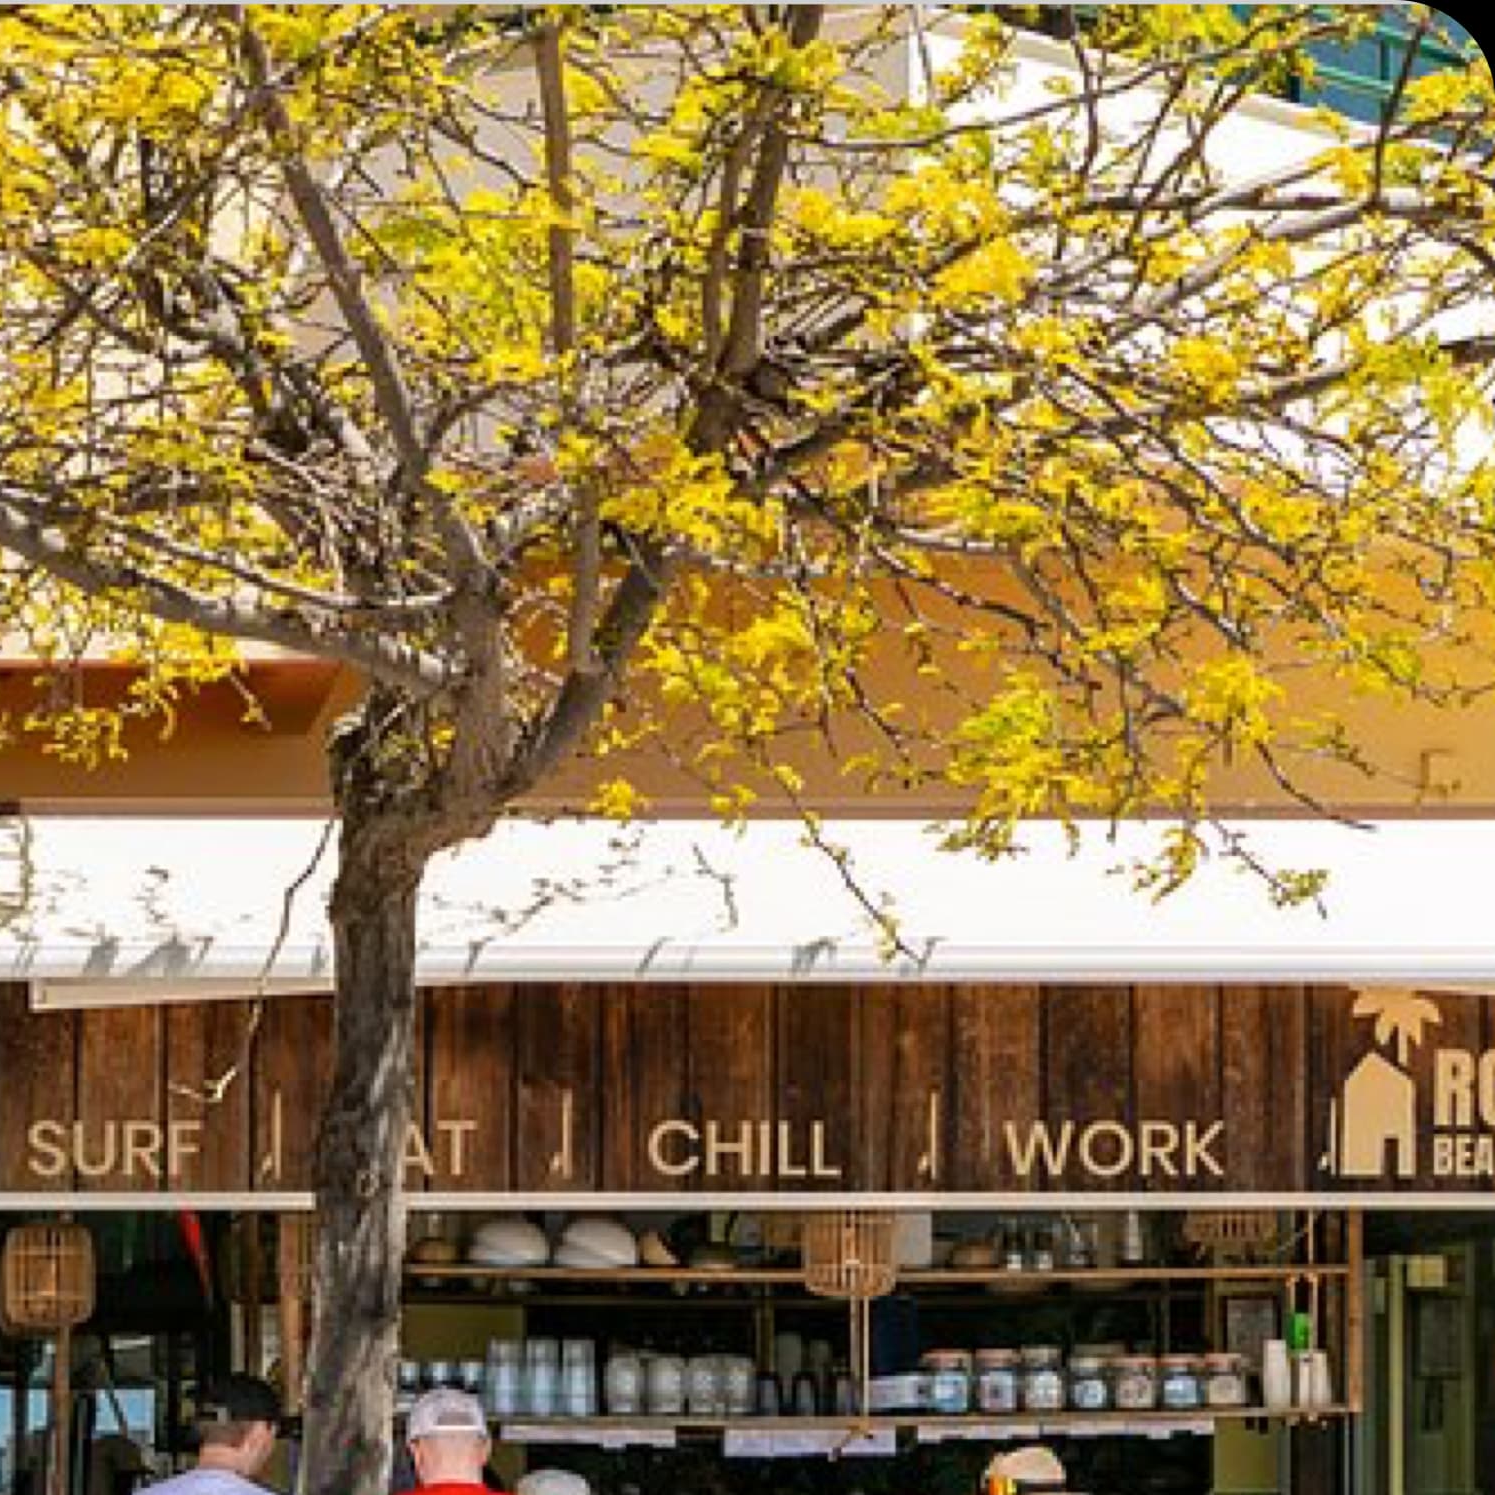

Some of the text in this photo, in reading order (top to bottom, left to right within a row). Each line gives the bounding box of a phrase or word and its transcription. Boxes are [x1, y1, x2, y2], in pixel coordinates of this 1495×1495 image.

[27, 1119, 1226, 1177] SURF AT CHILL WORK
